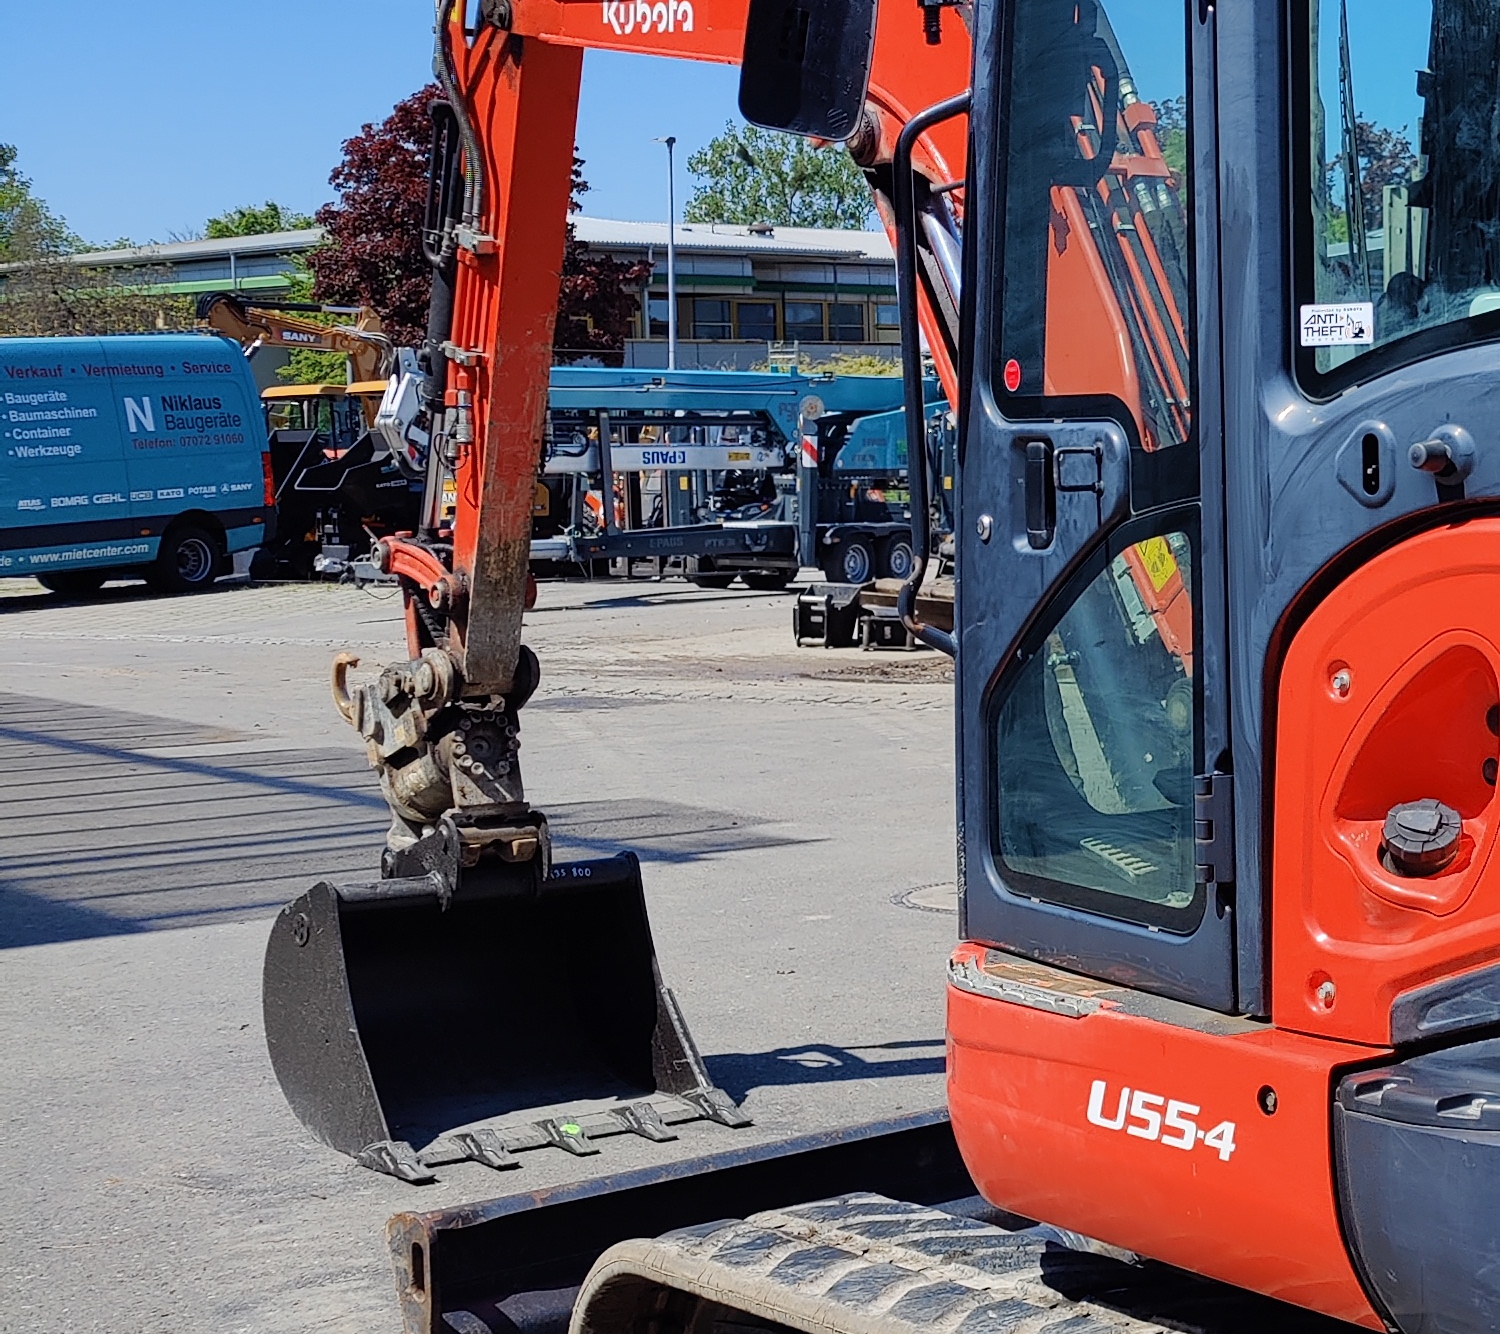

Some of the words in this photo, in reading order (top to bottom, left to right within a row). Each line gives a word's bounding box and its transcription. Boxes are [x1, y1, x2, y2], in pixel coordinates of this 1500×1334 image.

[1305, 313, 1338, 325] ANTI
[282, 331, 316, 342] SANY
[1304, 325, 1345, 337] THEFT
[5, 365, 63, 378] Verkauf
[82, 364, 164, 378] Vermietung
[182, 361, 232, 373] Service
[5, 391, 67, 405] Baugeräte
[161, 395, 222, 412] Niklaus
[9, 408, 97, 422] Baumaschinen
[124, 396, 156, 433] N
[165, 413, 241, 433] Baugeräte
[13, 427, 71, 440] Container
[15, 445, 82, 457] Werkzeuge
[51, 496, 89, 508] BOMAG
[93, 493, 127, 504] GEHL
[158, 488, 184, 499] KATO
[231, 484, 253, 492] SANY
[29, 542, 149, 564] www.mietcenter.com
